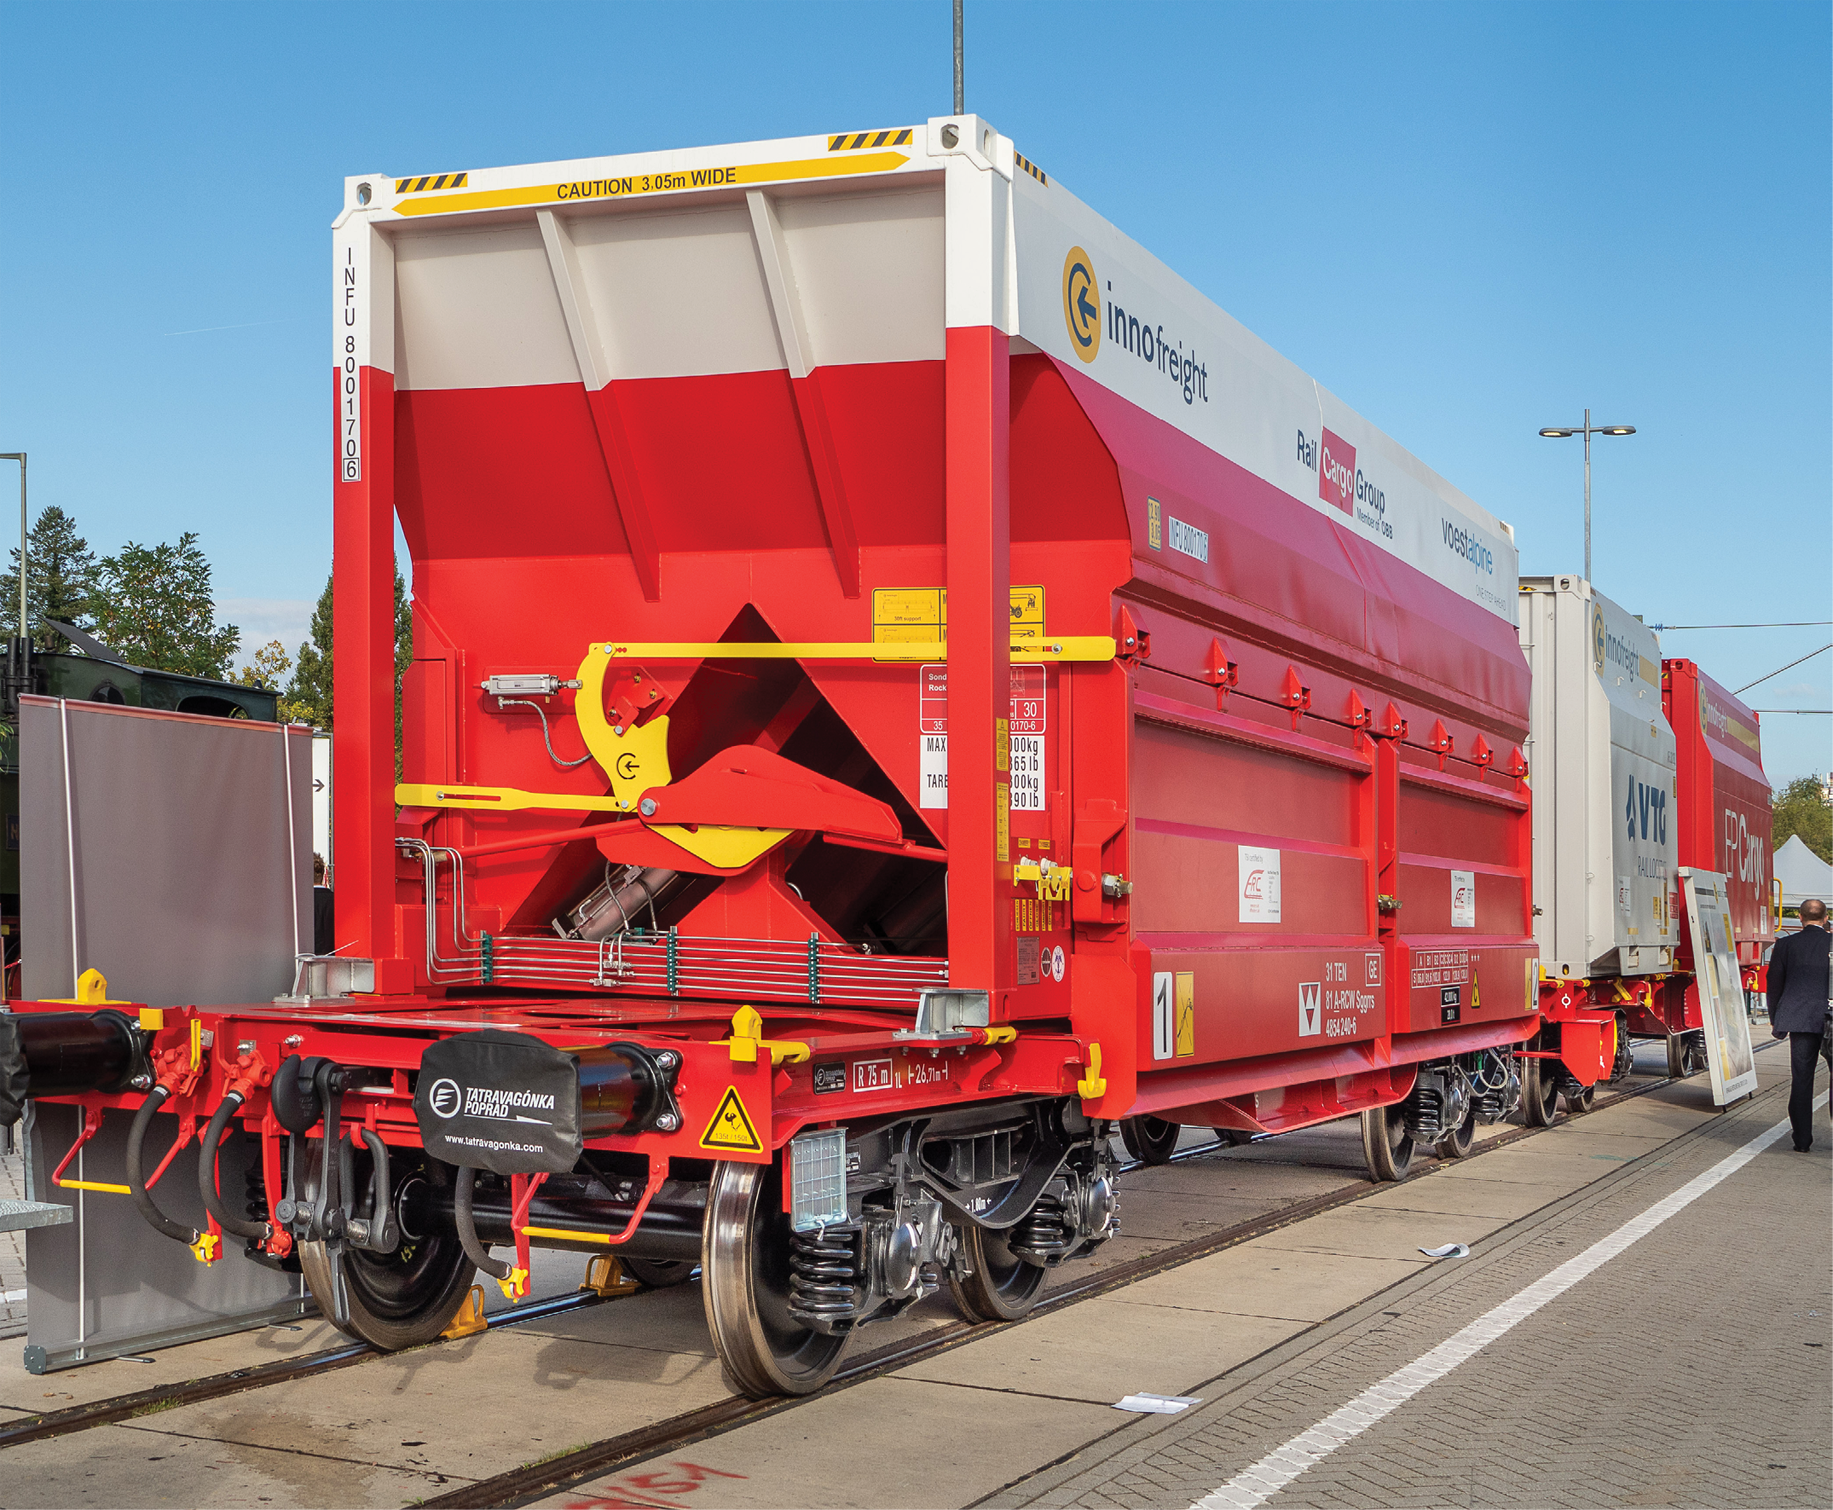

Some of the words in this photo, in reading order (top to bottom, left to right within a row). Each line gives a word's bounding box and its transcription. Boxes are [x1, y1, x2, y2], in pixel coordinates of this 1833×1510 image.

[557, 178, 633, 199] CAUTION
[691, 167, 736, 186] WIDE
[1107, 280, 1208, 405] innofreight
[1297, 429, 1317, 472] Rail
[1322, 446, 1354, 498] Cargo
[1355, 469, 1386, 520] Group
[1442, 517, 1493, 575] voestalpine
[1605, 624, 1640, 683] innofreight
[928, 684, 947, 692] Rock
[1023, 702, 1037, 718] 30
[933, 721, 943, 731] 35
[927, 737, 946, 752] MAX
[1029, 756, 1039, 771] lb
[1029, 792, 1039, 807] lb
[1638, 782, 1666, 846] VTG
[1738, 813, 1765, 901] Cargo
[1325, 962, 1333, 982] 31
[1334, 962, 1347, 982] TEN
[1368, 960, 1378, 979] GE
[1533, 962, 1538, 1006] 2
[1325, 990, 1333, 1010] 81
[1157, 978, 1167, 1053] 1
[858, 1066, 864, 1087] R
[868, 1065, 877, 1086] 75
[880, 1069, 888, 1084] m
[895, 1072, 903, 1088] 1L
[466, 1087, 555, 1110] TATRAVAGÓNKA
[464, 1101, 509, 1118] POPRAD
[445, 1135, 543, 1153] www.tatravagonka.com
